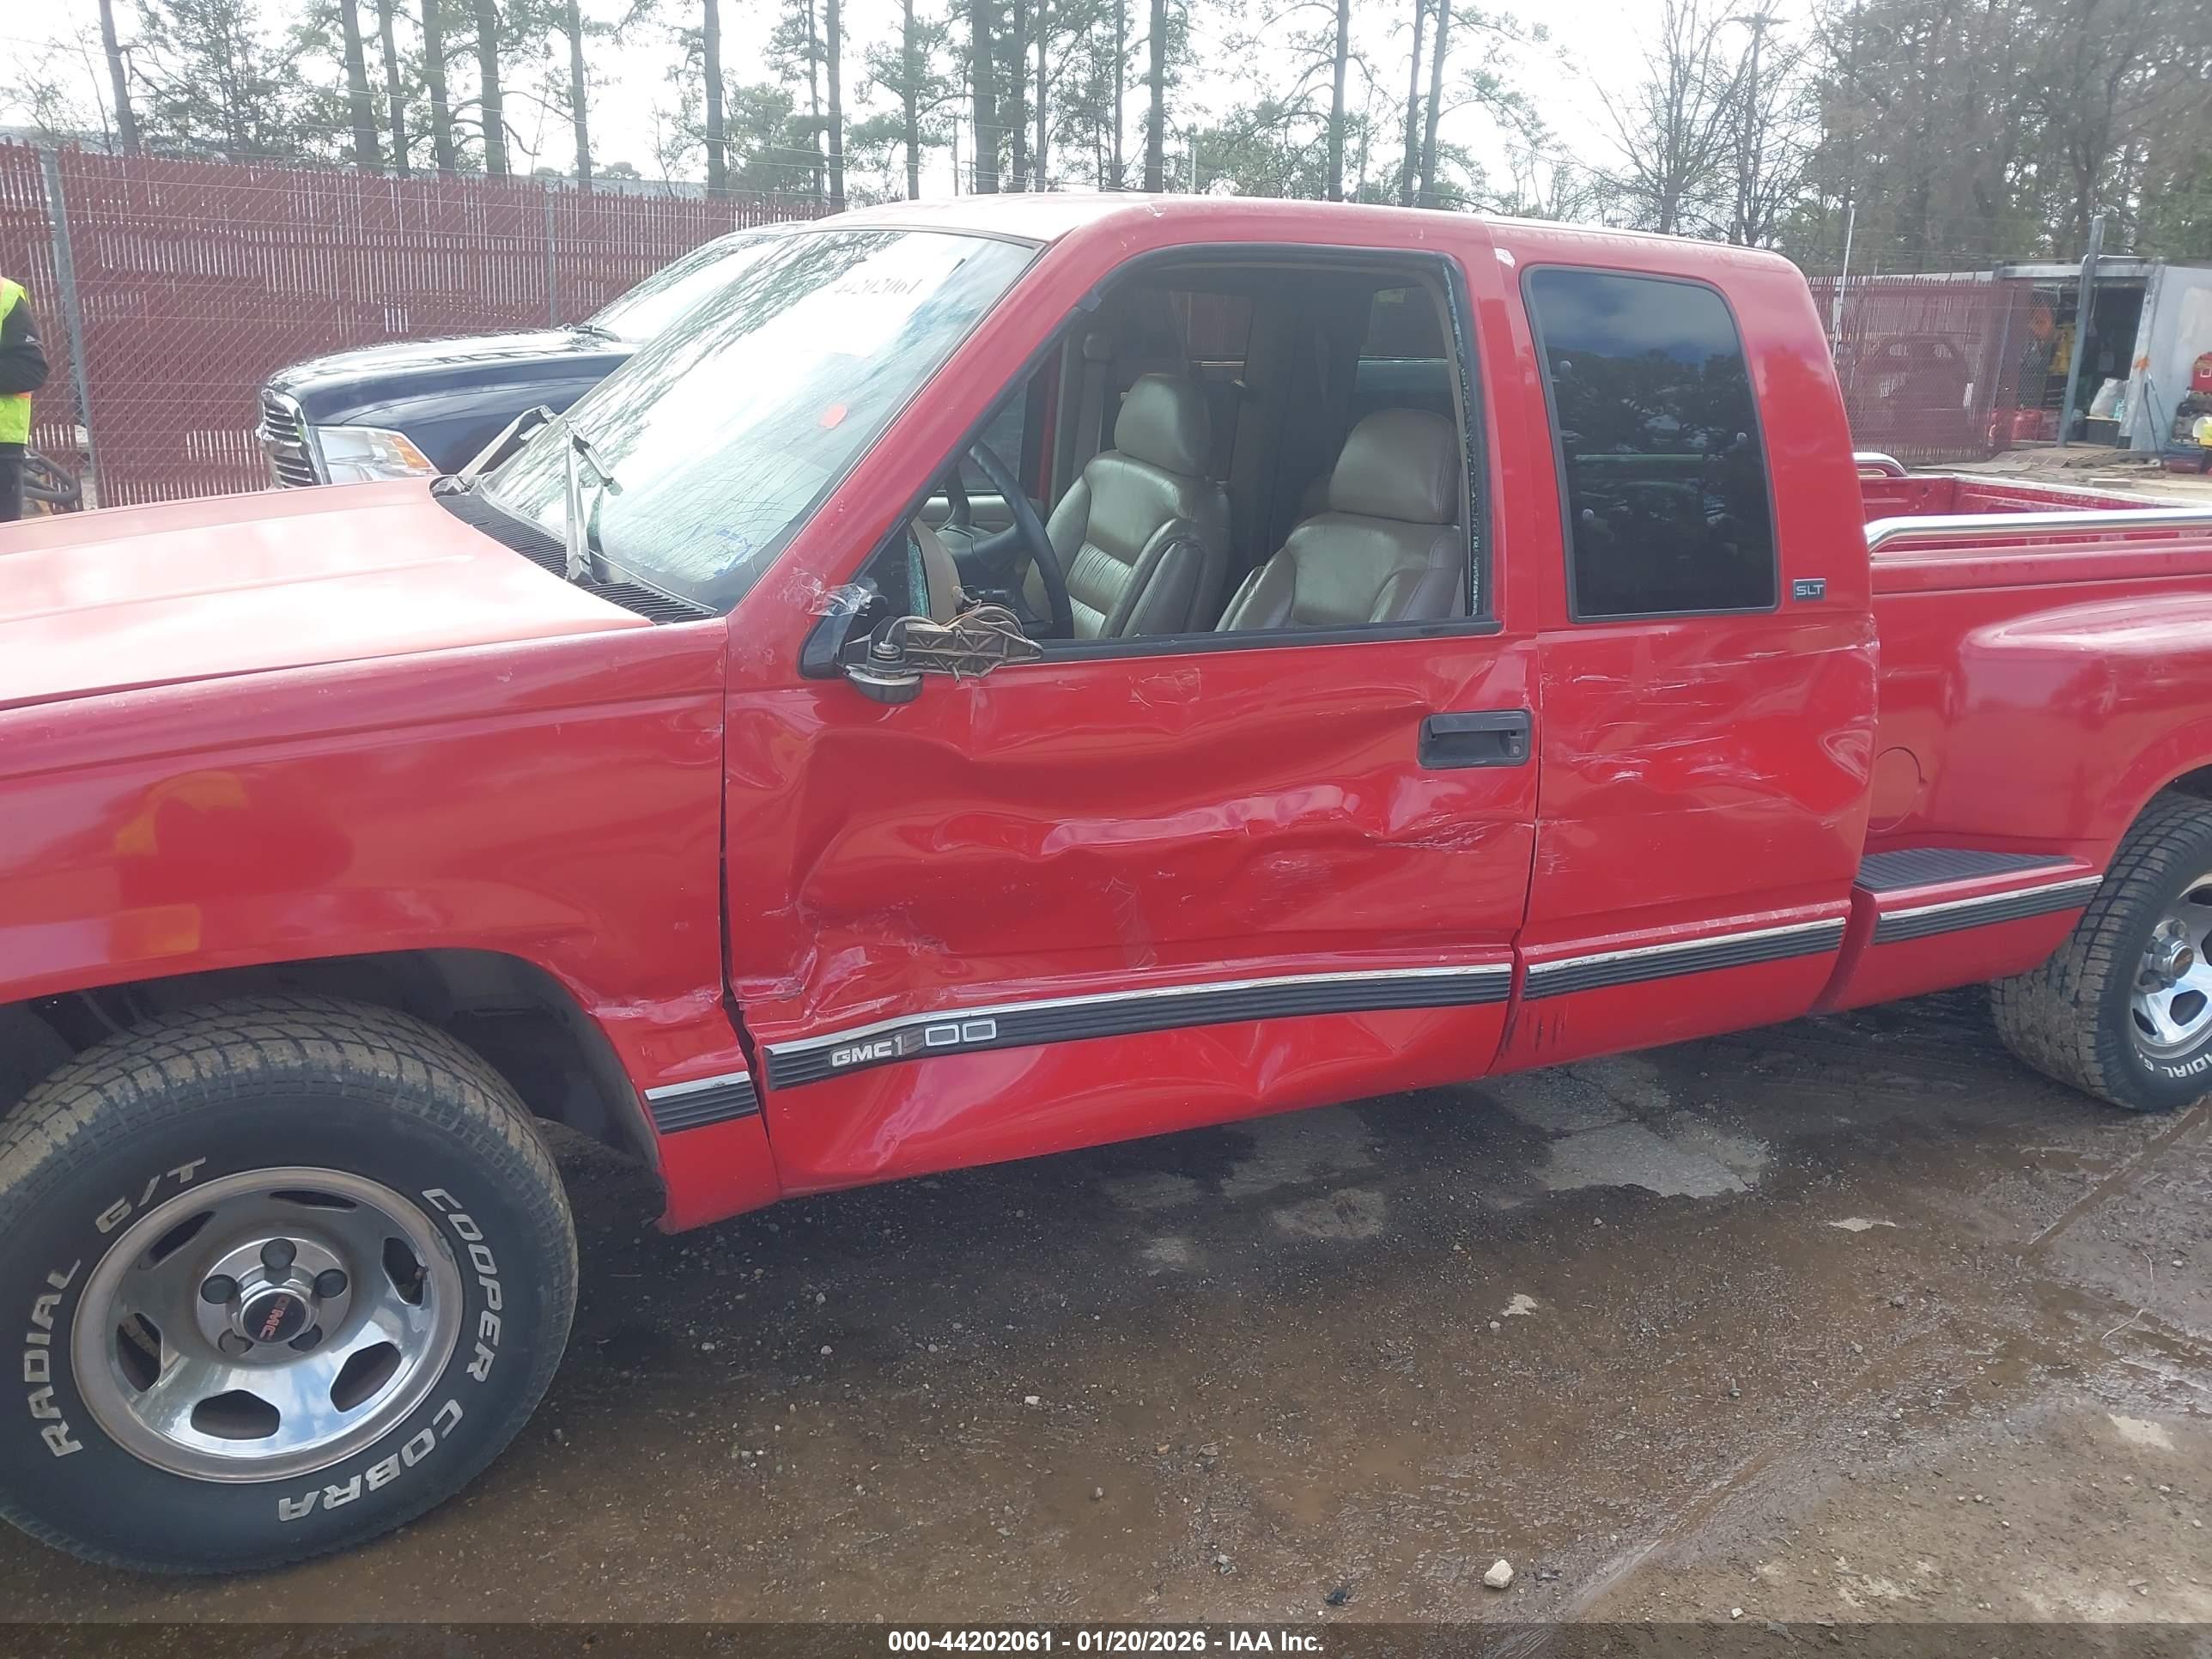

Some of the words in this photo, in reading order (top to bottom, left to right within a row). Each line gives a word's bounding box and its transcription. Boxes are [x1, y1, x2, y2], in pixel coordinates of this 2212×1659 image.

[1796, 584, 1825, 596] SLT
[94, 1156, 207, 1235] G/T
[422, 1188, 503, 1383] COOPER
[23, 1258, 84, 1458] RADIAL
[277, 1398, 465, 1522] COBRA
